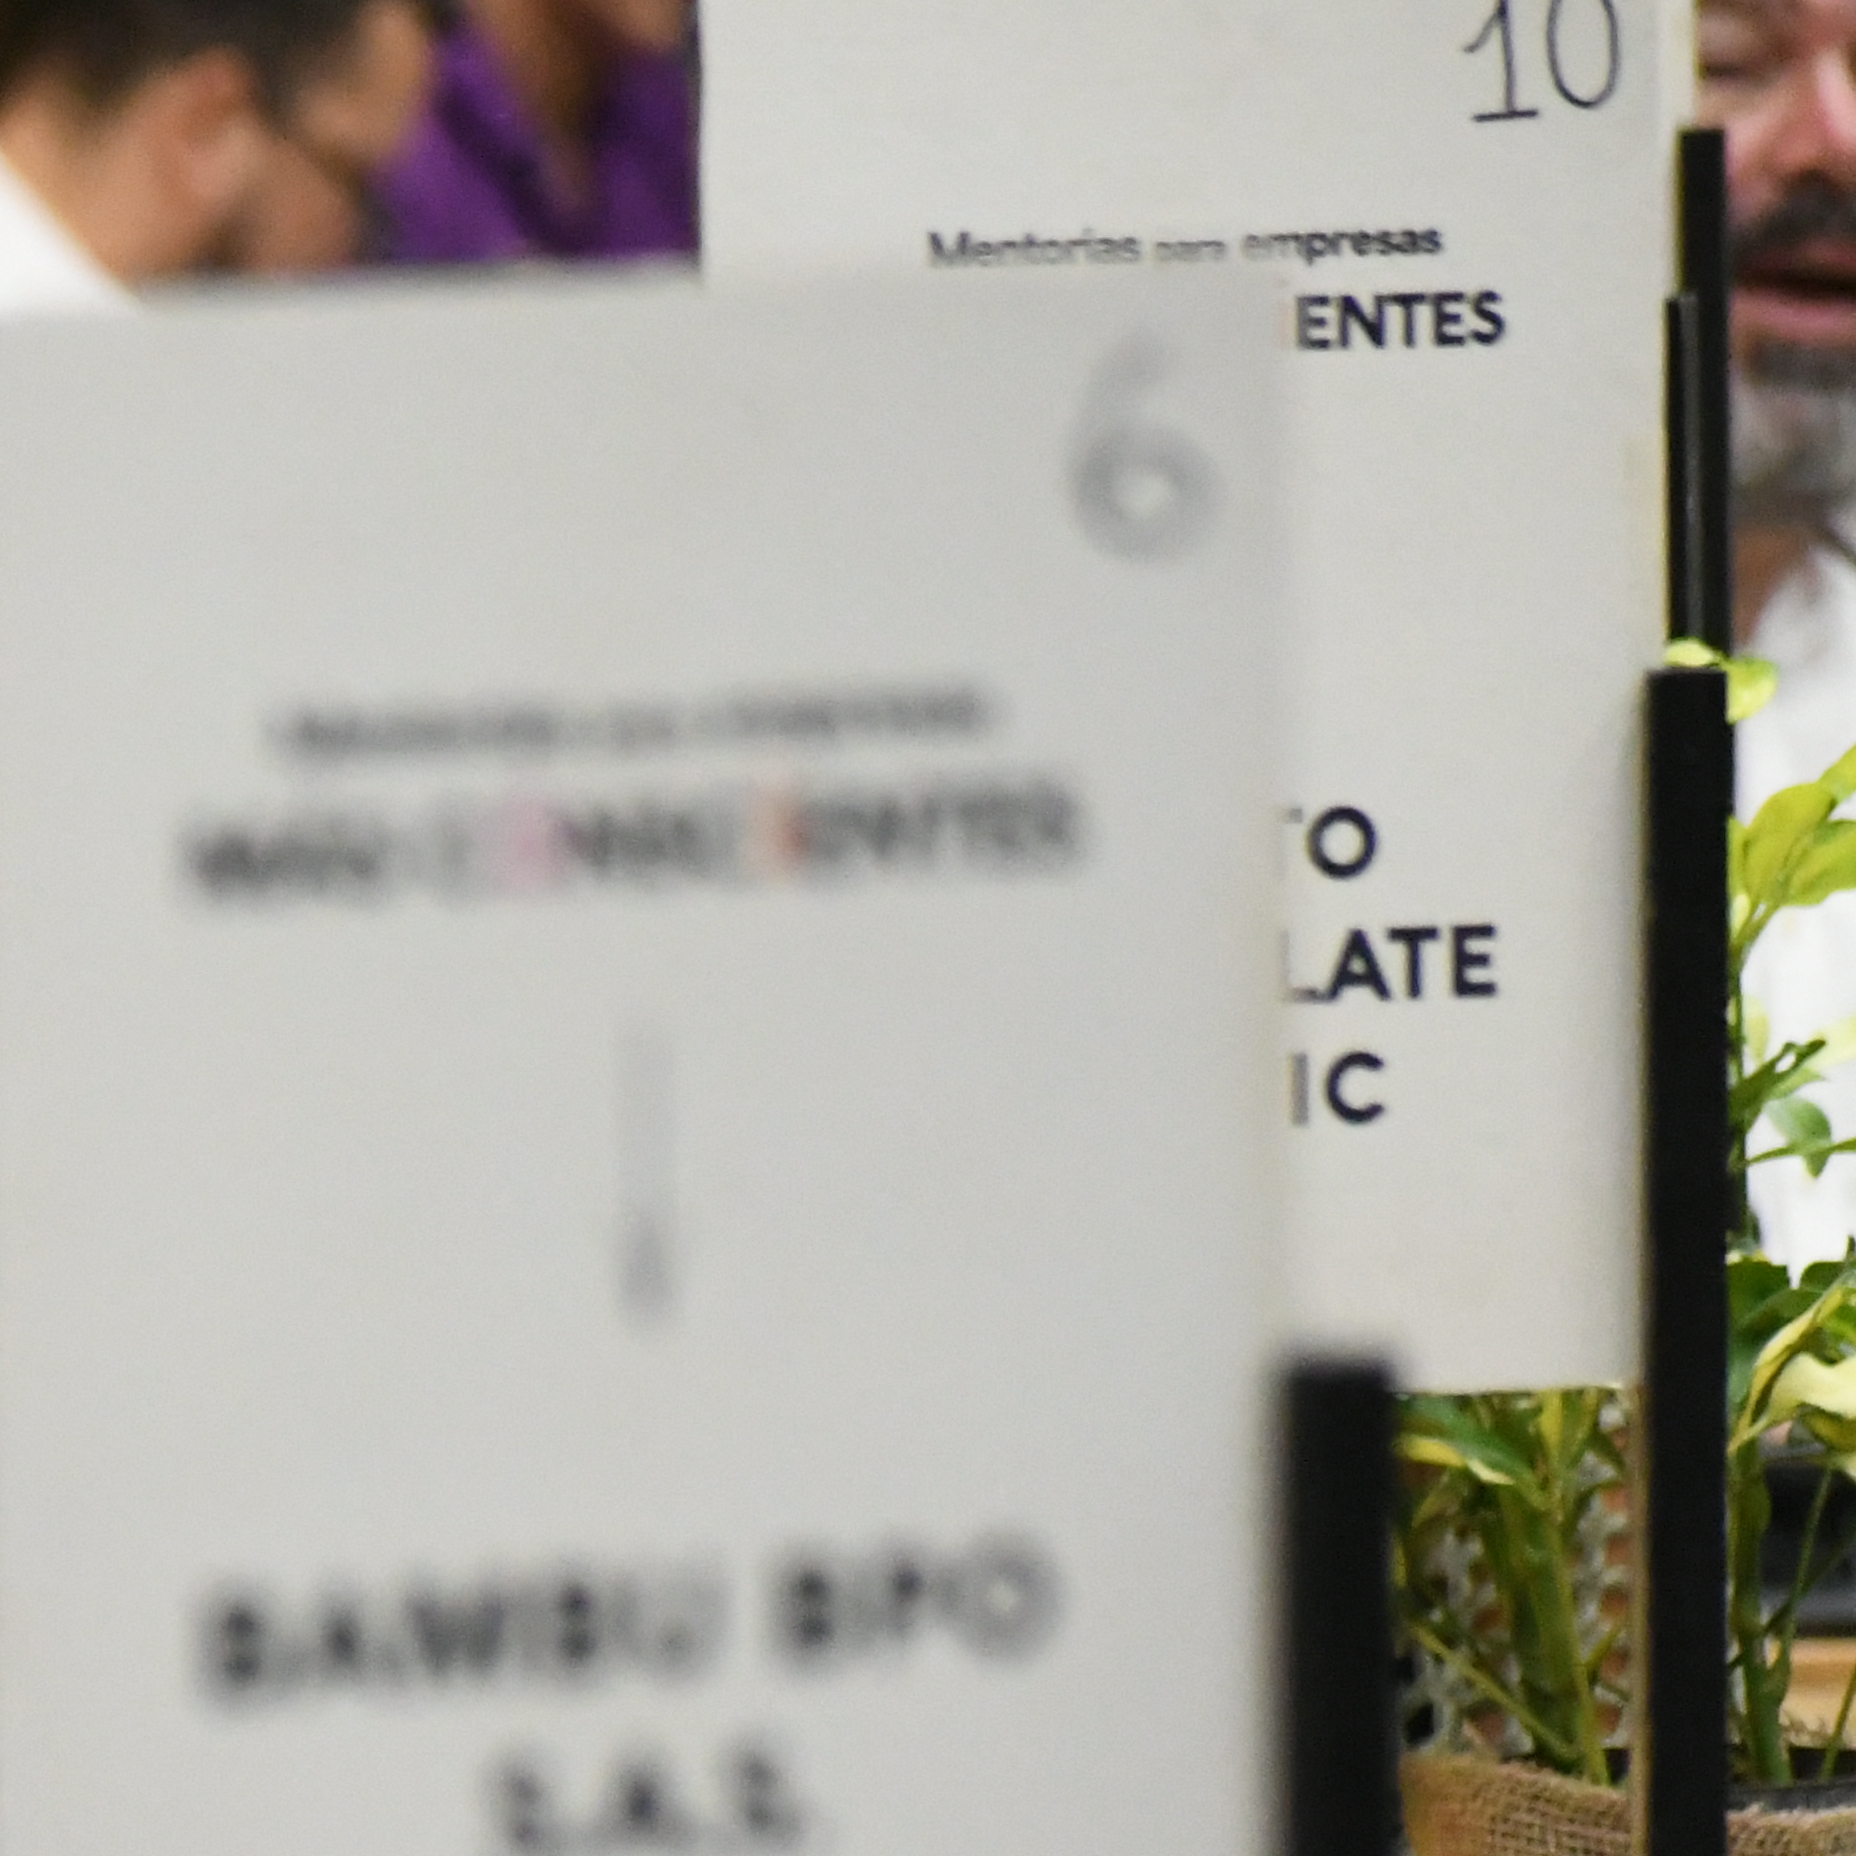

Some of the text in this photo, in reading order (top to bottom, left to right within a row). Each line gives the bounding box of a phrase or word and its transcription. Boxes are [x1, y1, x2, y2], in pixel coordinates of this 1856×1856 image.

[1460, 0, 1622, 123] 10
[1292, 289, 1506, 352] ENTES
[1064, 328, 1224, 565] 6
[1290, 1050, 1386, 1124] IC
[198, 1532, 1063, 1715] BAMBU BPO
